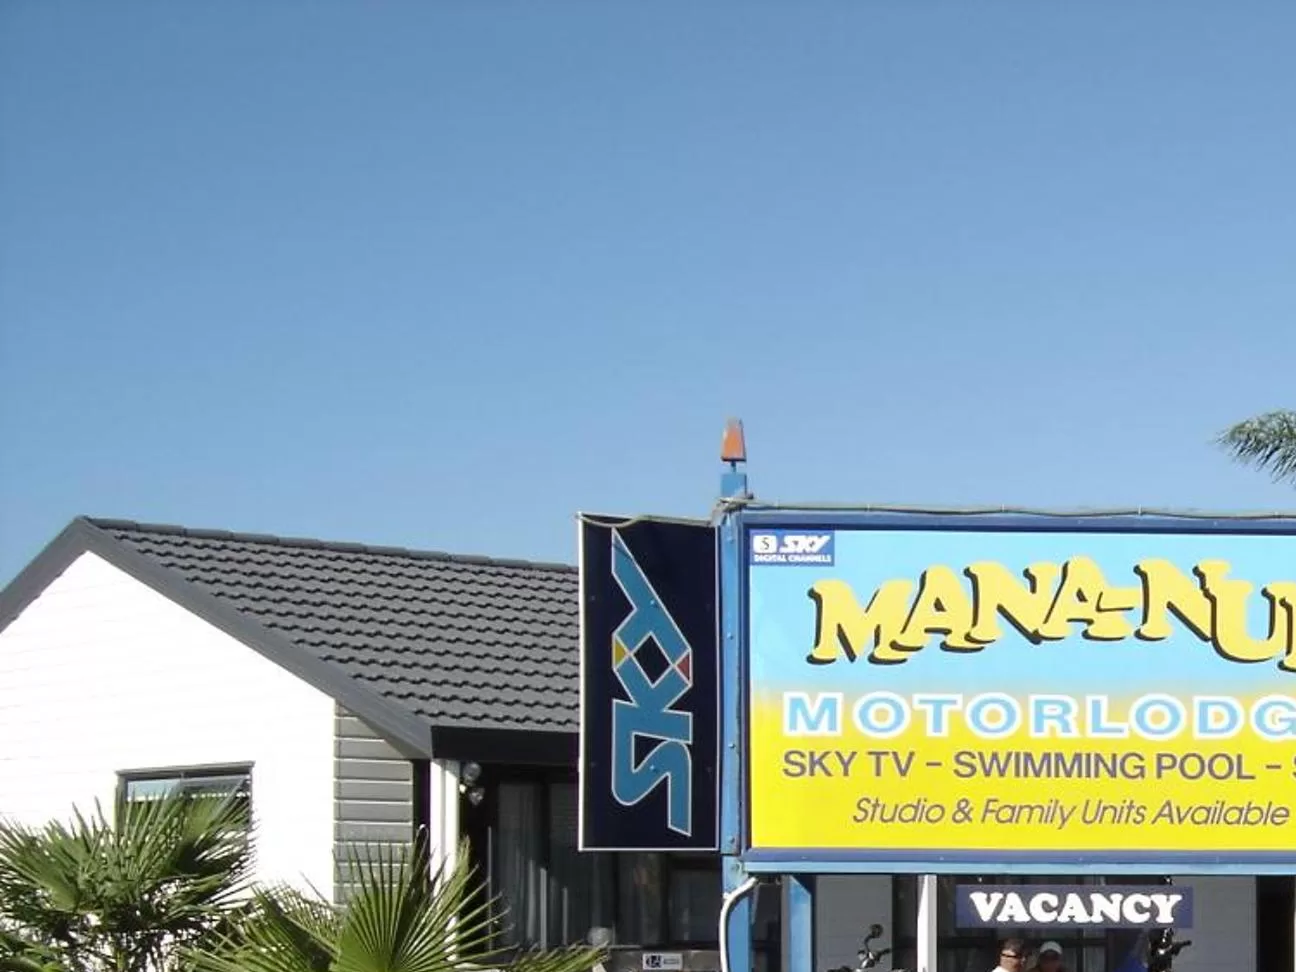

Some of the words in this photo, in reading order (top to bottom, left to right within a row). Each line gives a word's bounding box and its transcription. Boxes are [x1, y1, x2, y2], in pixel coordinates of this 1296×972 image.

[754, 554, 786, 562] DIGITAL
[788, 554, 832, 562] CHANNELS
[779, 535, 831, 553] SKY
[611, 526, 692, 837] SKY
[782, 750, 857, 778] SKY
[867, 750, 915, 778] TV
[952, 751, 1146, 779] SWIMMING
[1155, 752, 1256, 781] POOL
[852, 796, 946, 825] Studio
[951, 797, 973, 825] &
[980, 797, 1077, 830] Family
[1080, 798, 1147, 825] Units
[1150, 799, 1291, 827] Available
[969, 891, 1183, 924] VACANCY
